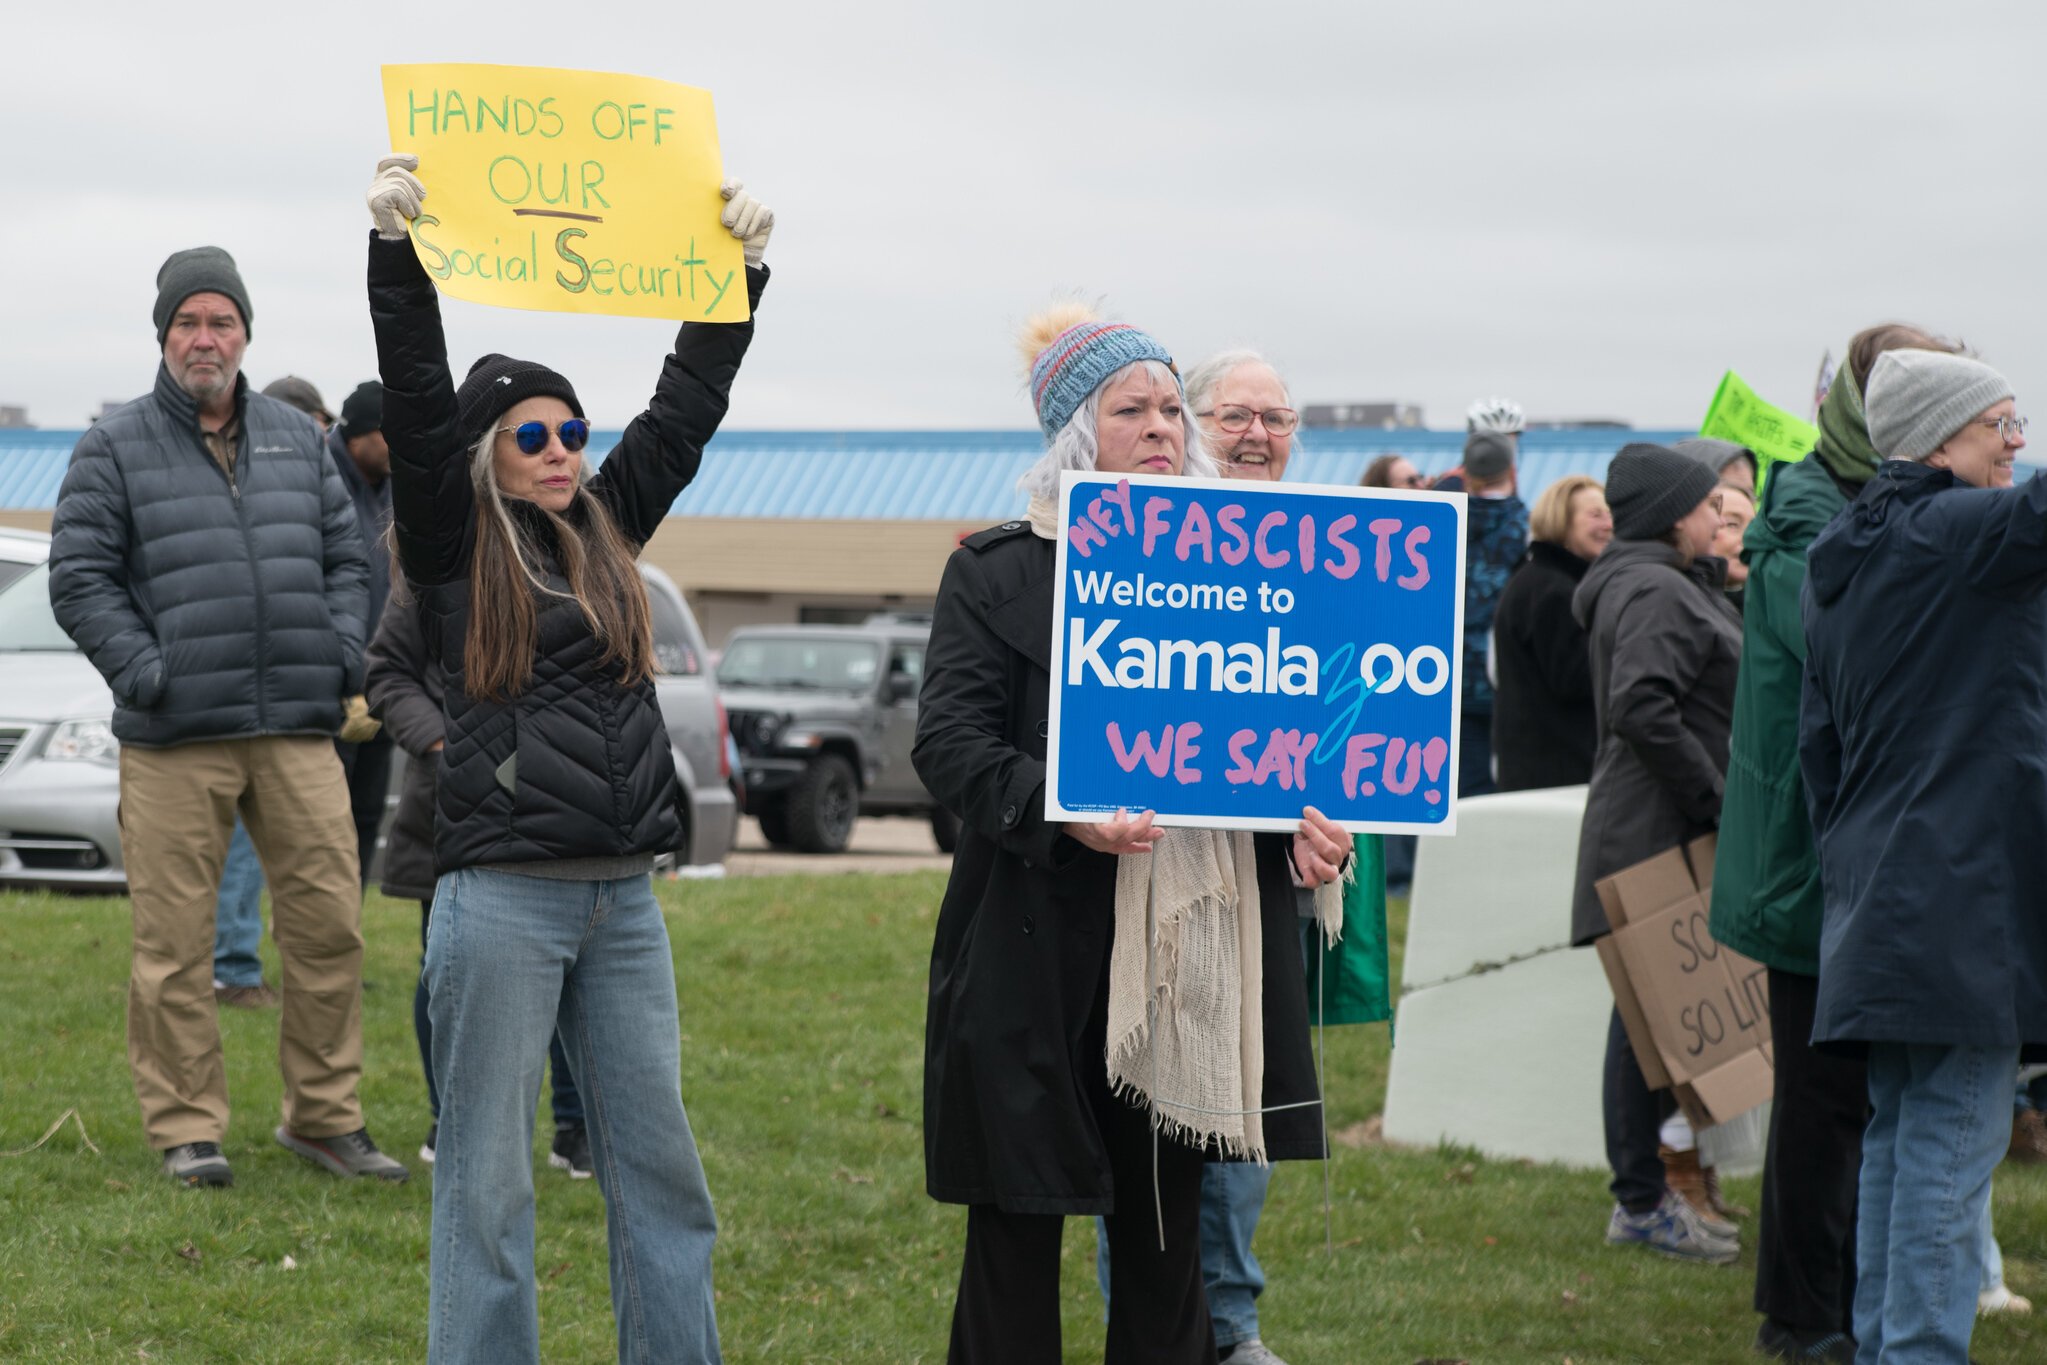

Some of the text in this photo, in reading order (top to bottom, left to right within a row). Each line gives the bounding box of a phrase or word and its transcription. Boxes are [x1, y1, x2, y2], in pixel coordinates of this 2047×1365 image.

[408, 89, 675, 146] HANDS OFF
[488, 155, 612, 209] OUR
[410, 214, 735, 316] Social Security
[1069, 479, 1431, 590] HEY FASCISTS
[1073, 569, 1295, 614] Welcome to
[1106, 721, 1203, 785] WE
[1225, 732, 1319, 791] SAY
[1671, 911, 1718, 973] SO
[1680, 998, 1725, 1056] SO
